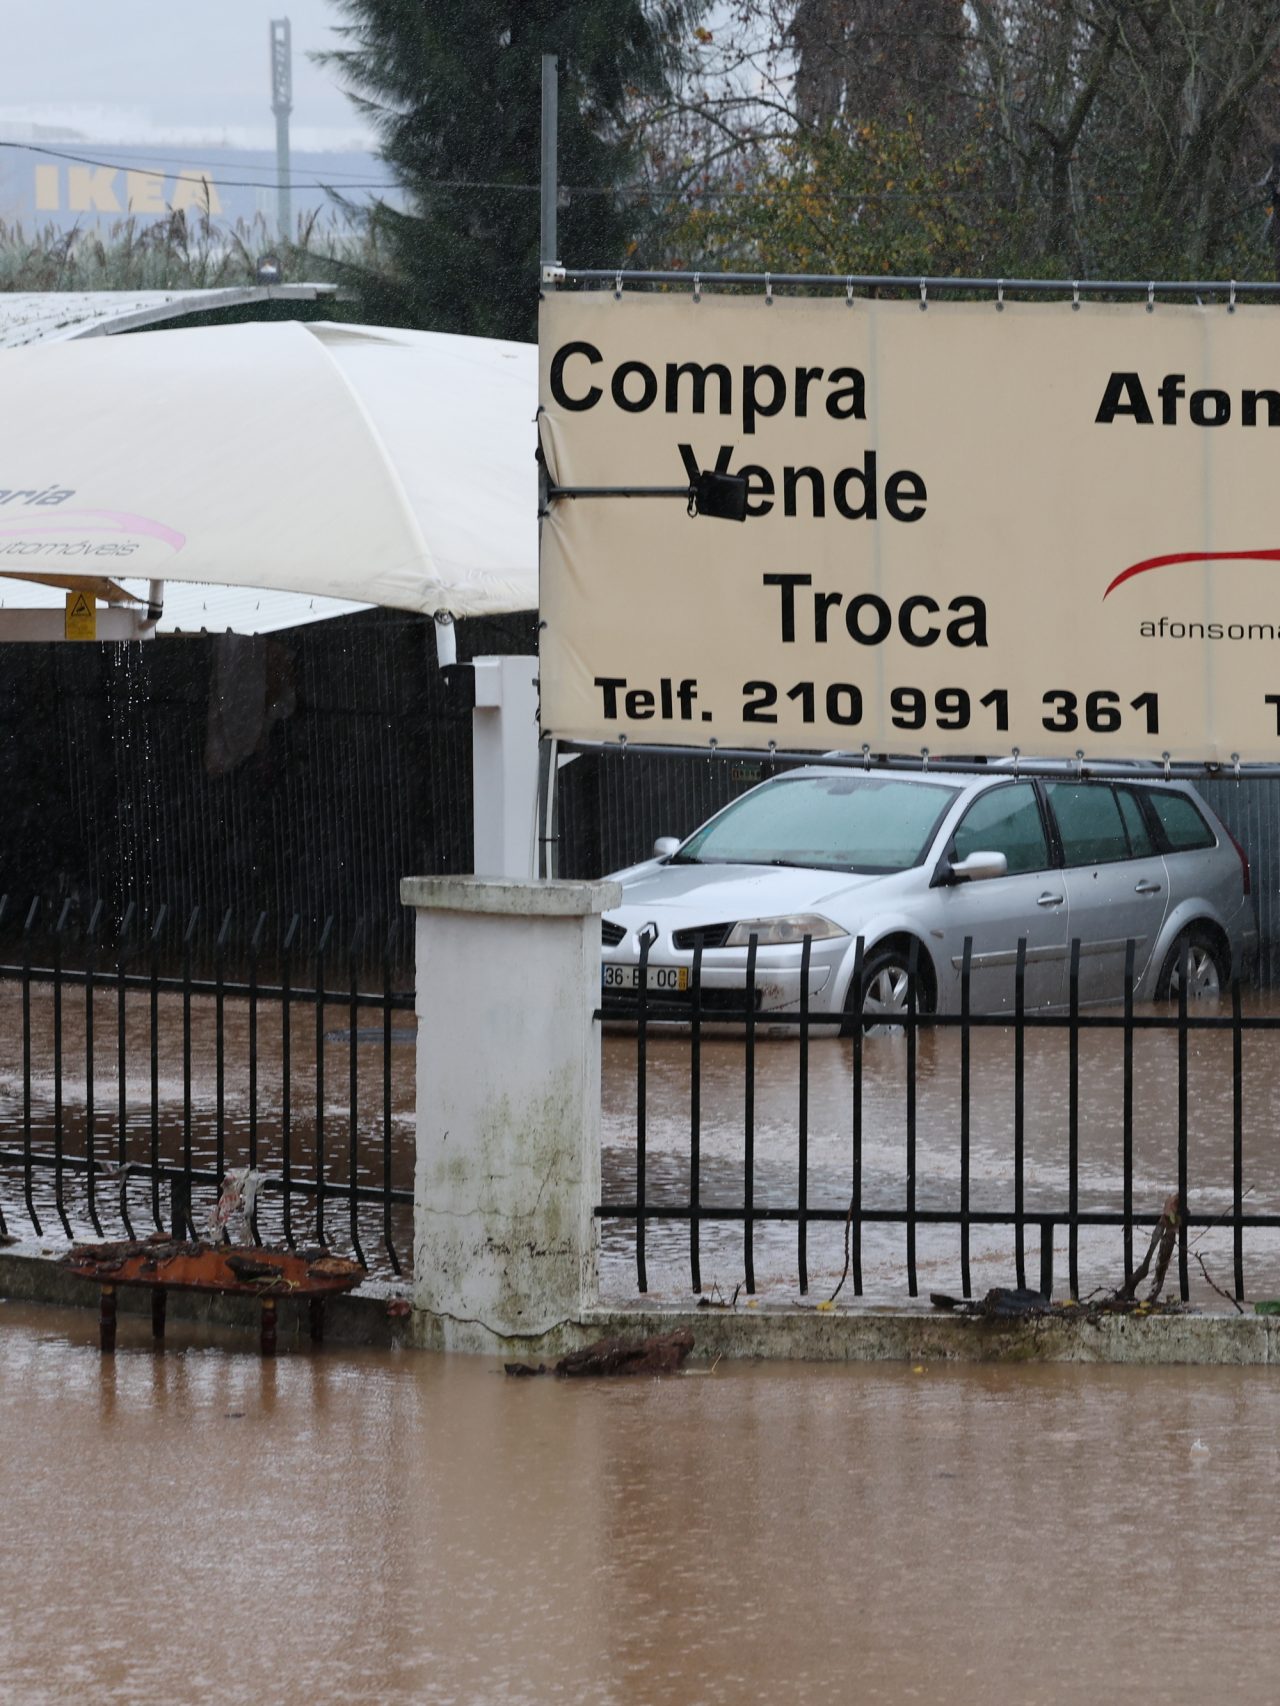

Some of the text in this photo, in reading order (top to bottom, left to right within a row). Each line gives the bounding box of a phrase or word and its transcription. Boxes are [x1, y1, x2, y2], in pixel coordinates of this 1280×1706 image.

[35, 164, 223, 215] IKEA
[549, 341, 867, 435] Compra
[762, 572, 989, 648] Troca
[593, 677, 1159, 736] Telf. 210 991 361
